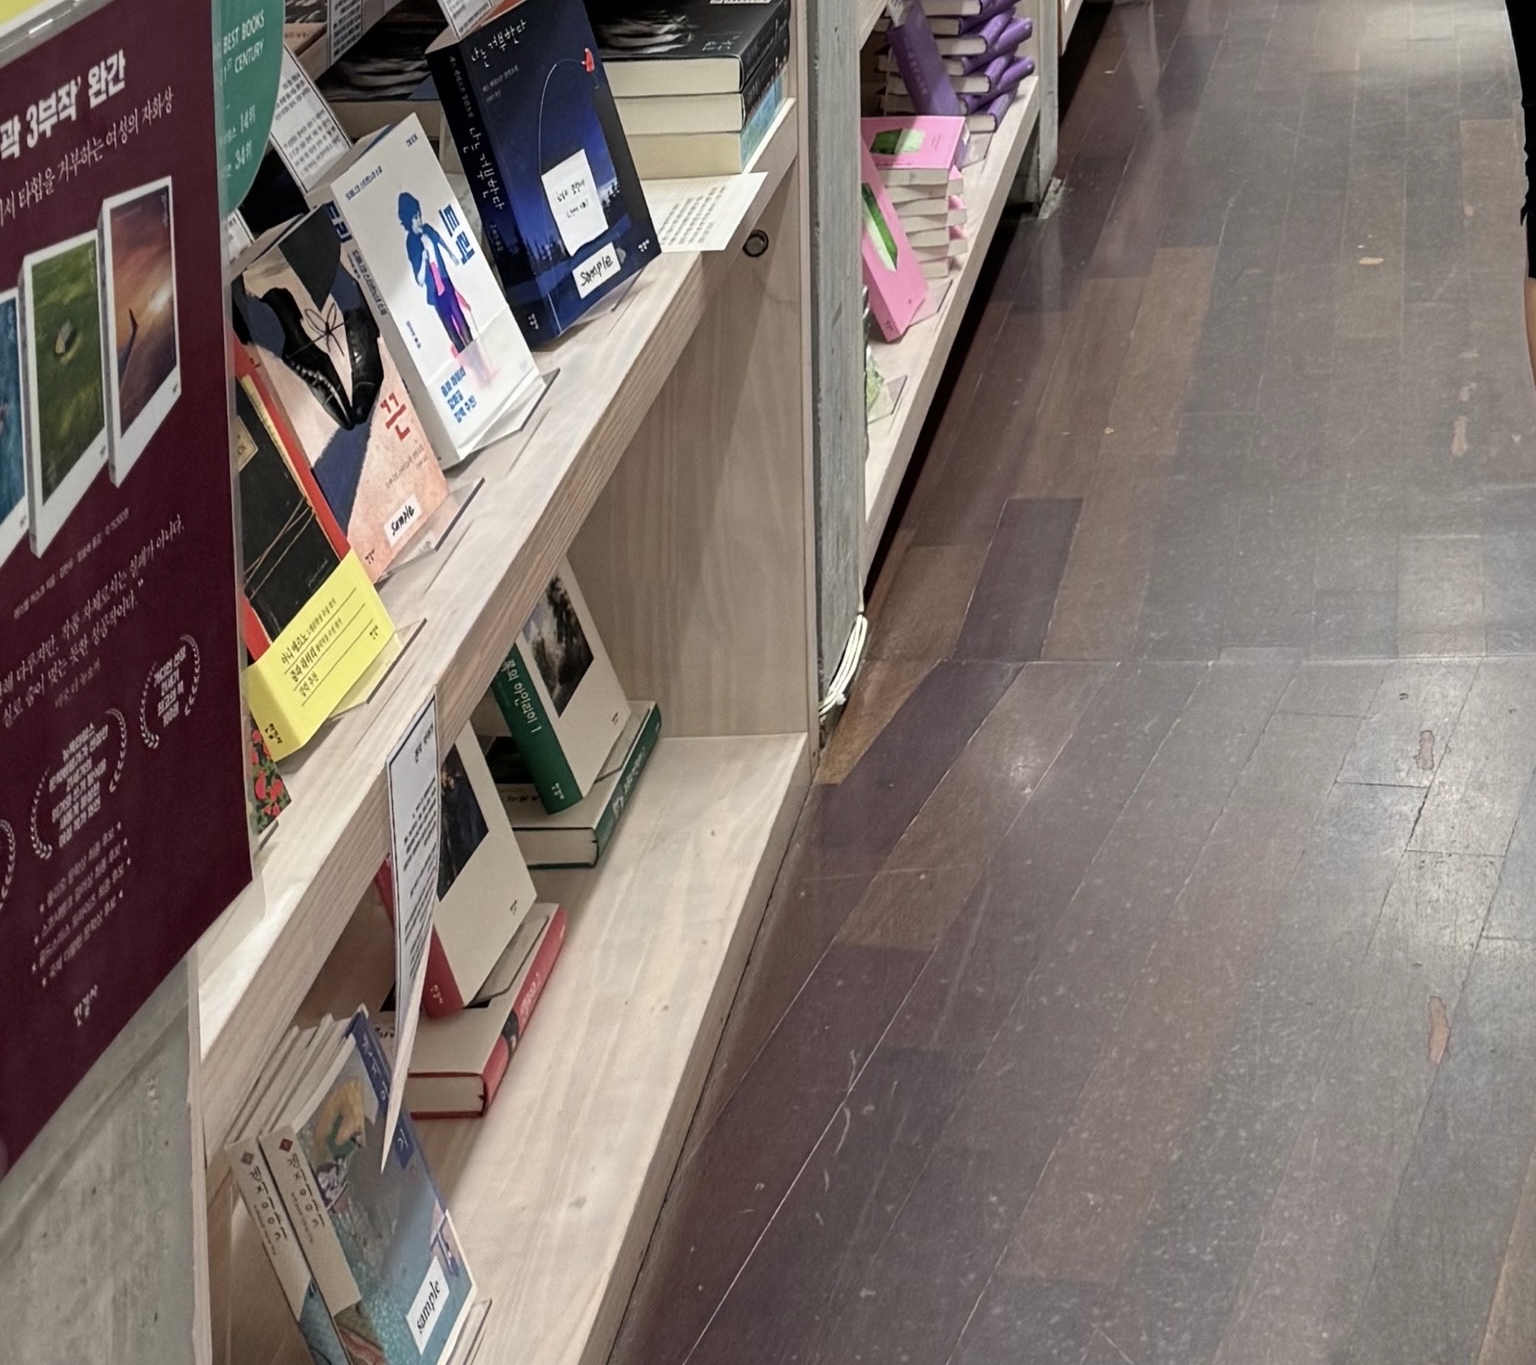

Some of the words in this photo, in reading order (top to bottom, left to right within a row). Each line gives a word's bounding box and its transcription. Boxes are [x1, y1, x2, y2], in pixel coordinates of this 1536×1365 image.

[222, 26, 240, 55] BEST
[241, 8, 265, 41] BOOKS
[470, 45, 490, 69] 나는
[487, 19, 528, 55] 거부한다
[87, 48, 126, 109] 완간
[233, 37, 265, 75] CENTURY
[239, 103, 257, 135] 14위
[18, 167, 56, 209] 타협을
[56, 135, 105, 183] 거부하는
[105, 107, 140, 149] 여성의
[141, 84, 175, 126] 자화상
[462, 127, 483, 155] 나는
[475, 153, 506, 210] 거부한다
[438, 202, 477, 266] 트릭
[379, 391, 411, 442] 끈
[155, 513, 185, 549] 아니다.
[390, 502, 417, 537] sample
[281, 646, 294, 667] 아니
[291, 632, 309, 656] 에르노
[289, 666, 303, 688] 줌파
[300, 648, 318, 673] 라히리
[415, 1278, 442, 1335] sample
